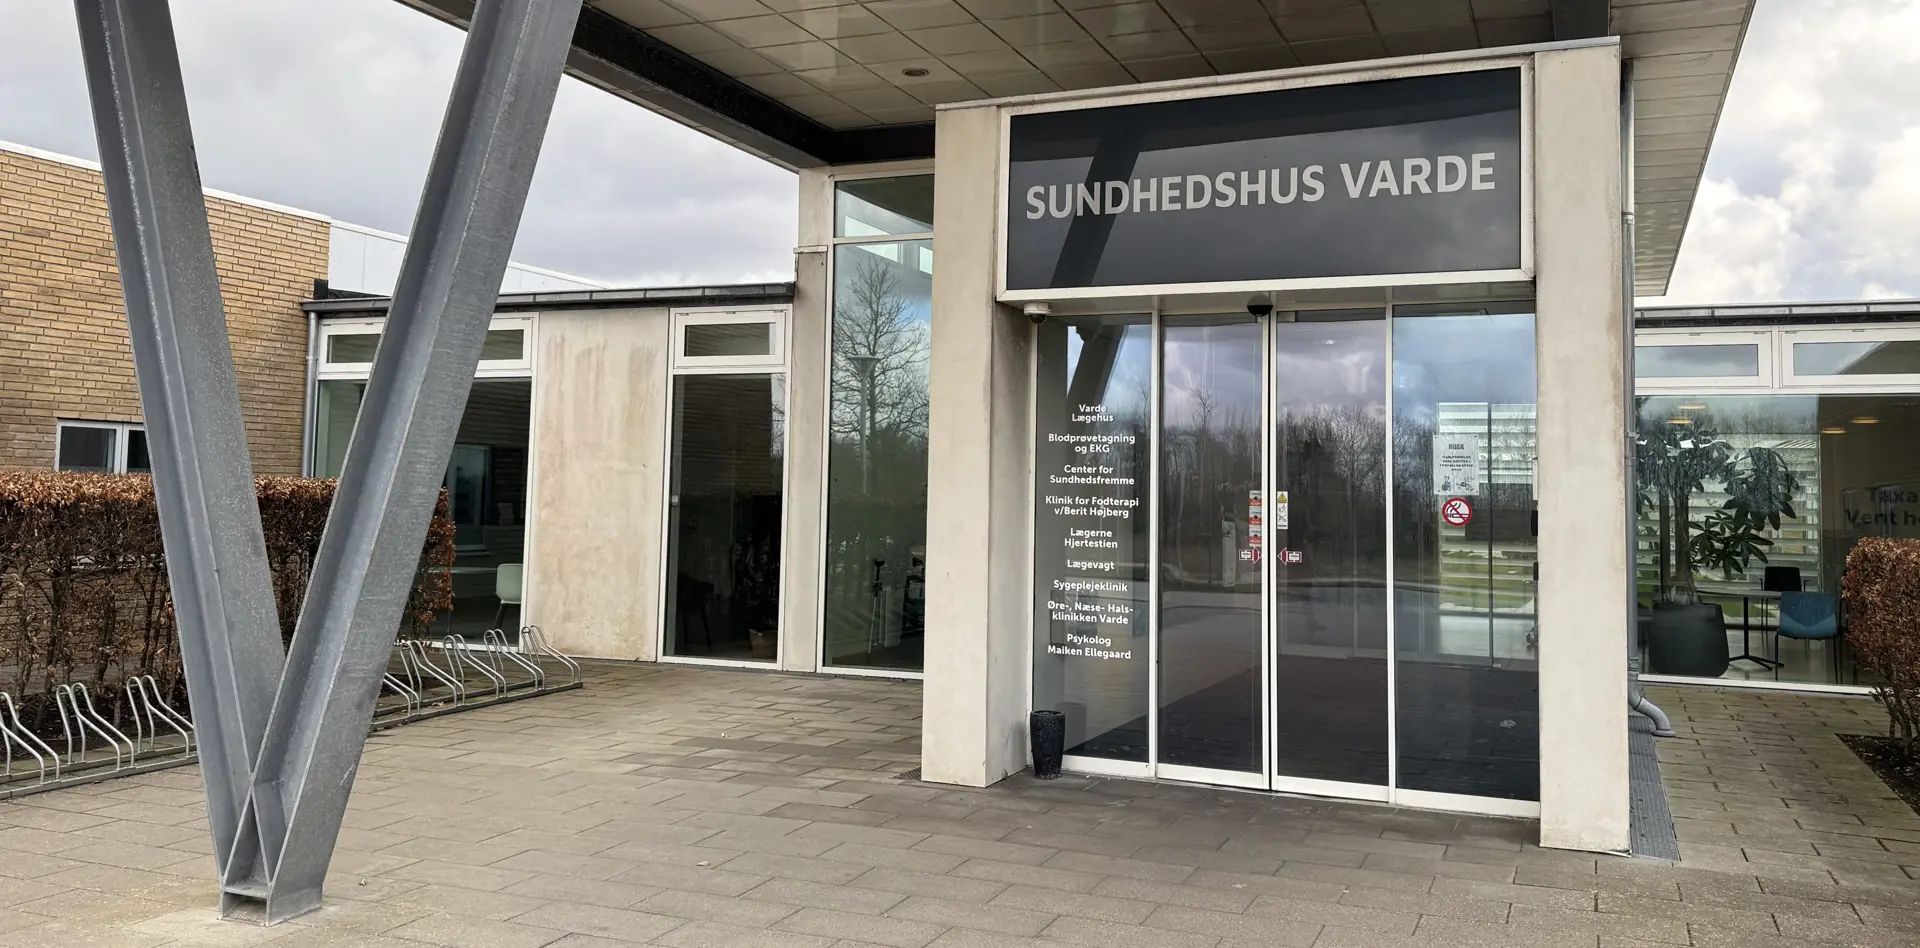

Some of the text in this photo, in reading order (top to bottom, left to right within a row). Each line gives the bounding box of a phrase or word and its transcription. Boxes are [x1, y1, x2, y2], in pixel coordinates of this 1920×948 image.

[1026, 152, 1496, 220] SUNDHEDSHUS VARDE
[1079, 404, 1107, 412] Varde
[1072, 414, 1114, 423] Lægehus
[1048, 434, 1136, 444] Blodprøvetagning
[1075, 444, 1110, 454] og EKG
[1064, 465, 1114, 473] Center for
[1050, 475, 1135, 485] Sundhedsfremme
[1046, 496, 1139, 508] Klinik for Fodterapi
[1054, 506, 1129, 518] v/Berit Højberg
[1844, 508, 1920, 525] Vent h
[1070, 528, 1112, 538] Lægerne
[1064, 538, 1118, 548] Hjertestien
[1067, 559, 1114, 571] Lægevagt
[1054, 580, 1128, 592] Sygeplejeklinik
[1048, 601, 1134, 614] Øre-, Næse- Hals-
[1052, 612, 1128, 624] klinikken Varde
[1067, 634, 1111, 647] Psykolog
[1048, 646, 1131, 659] Maiken Ellegaard
